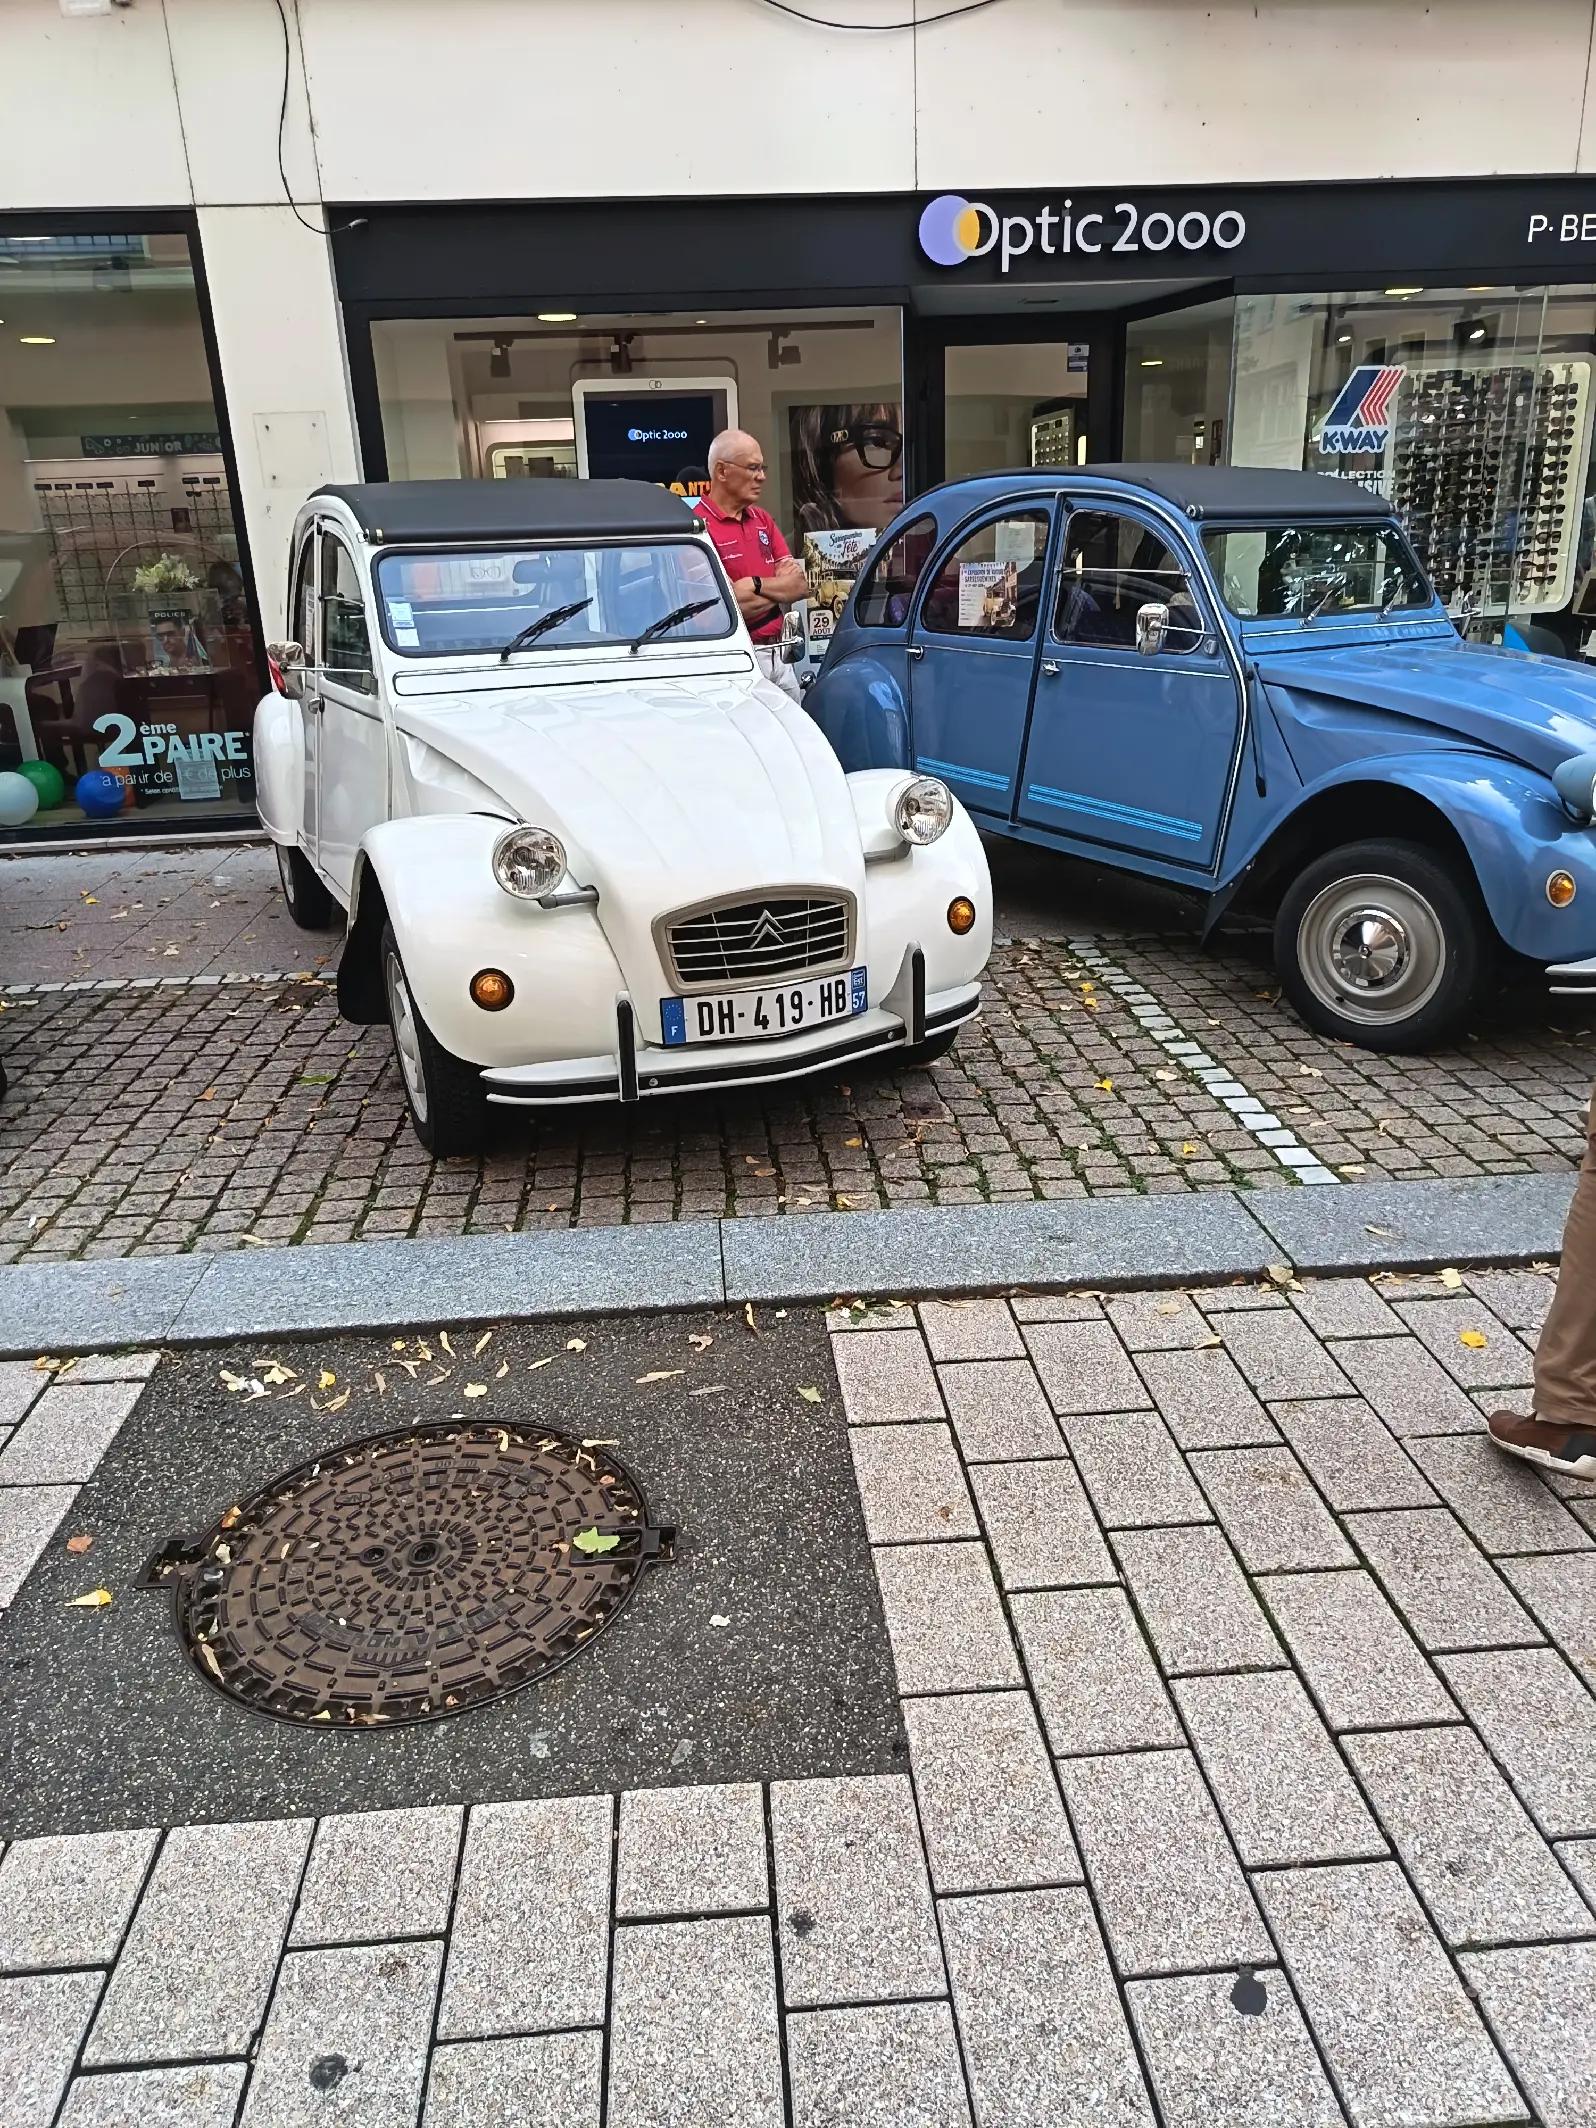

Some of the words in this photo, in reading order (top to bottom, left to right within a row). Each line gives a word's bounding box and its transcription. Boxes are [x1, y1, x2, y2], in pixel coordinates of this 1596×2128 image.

[953, 199, 1103, 272] Optic
[1111, 202, 1246, 252] 2000
[633, 429, 661, 442] Optic
[662, 429, 687, 439] 2000
[813, 616, 829, 628] 29
[154, 770, 173, 784] de
[222, 765, 252, 782] plus
[852, 991, 865, 1009] 57
[671, 1026, 678, 1037] F
